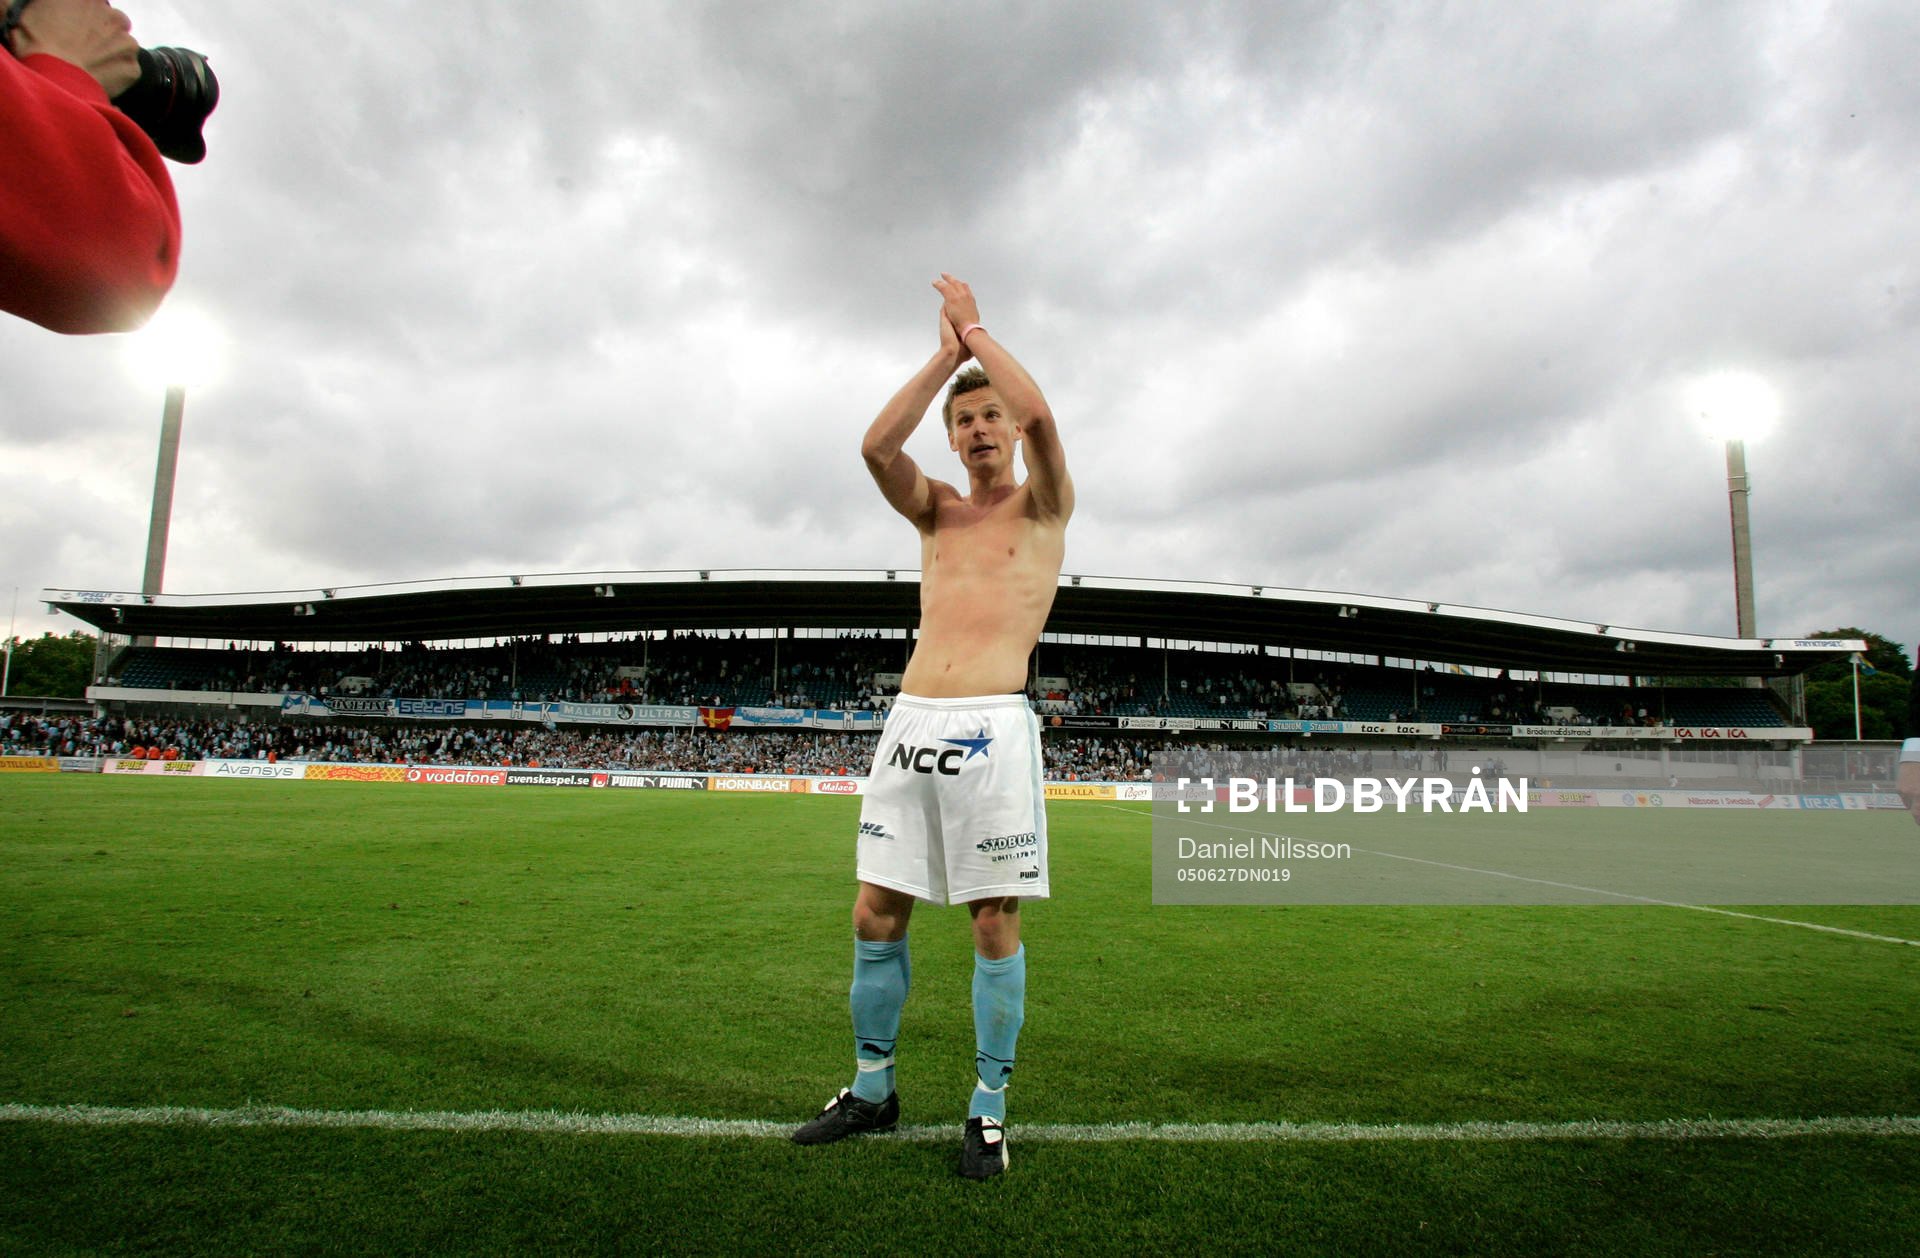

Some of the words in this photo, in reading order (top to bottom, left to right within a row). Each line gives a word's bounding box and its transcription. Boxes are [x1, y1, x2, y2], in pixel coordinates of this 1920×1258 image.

[639, 708, 691, 719] ULTRAS
[1194, 719, 1221, 729] PUMA
[1232, 720, 1258, 730] PUMA
[1674, 728, 1693, 738] ICA
[1700, 728, 1720, 738] ICA
[1727, 729, 1747, 738] ICA
[888, 743, 964, 775] NCC
[216, 762, 294, 777] Avansys
[426, 768, 500, 784] vodafone
[508, 775, 590, 786] svenskaspel.se
[611, 776, 648, 787] PUMA
[659, 777, 695, 788] PUMA
[716, 779, 789, 791] HORNBACH
[821, 782, 855, 792] Malaco
[1048, 788, 1070, 796] TILL
[1070, 788, 1094, 796] ALLA
[980, 832, 1036, 852] SYDBUS
[1019, 871, 1039, 879] PUMA
